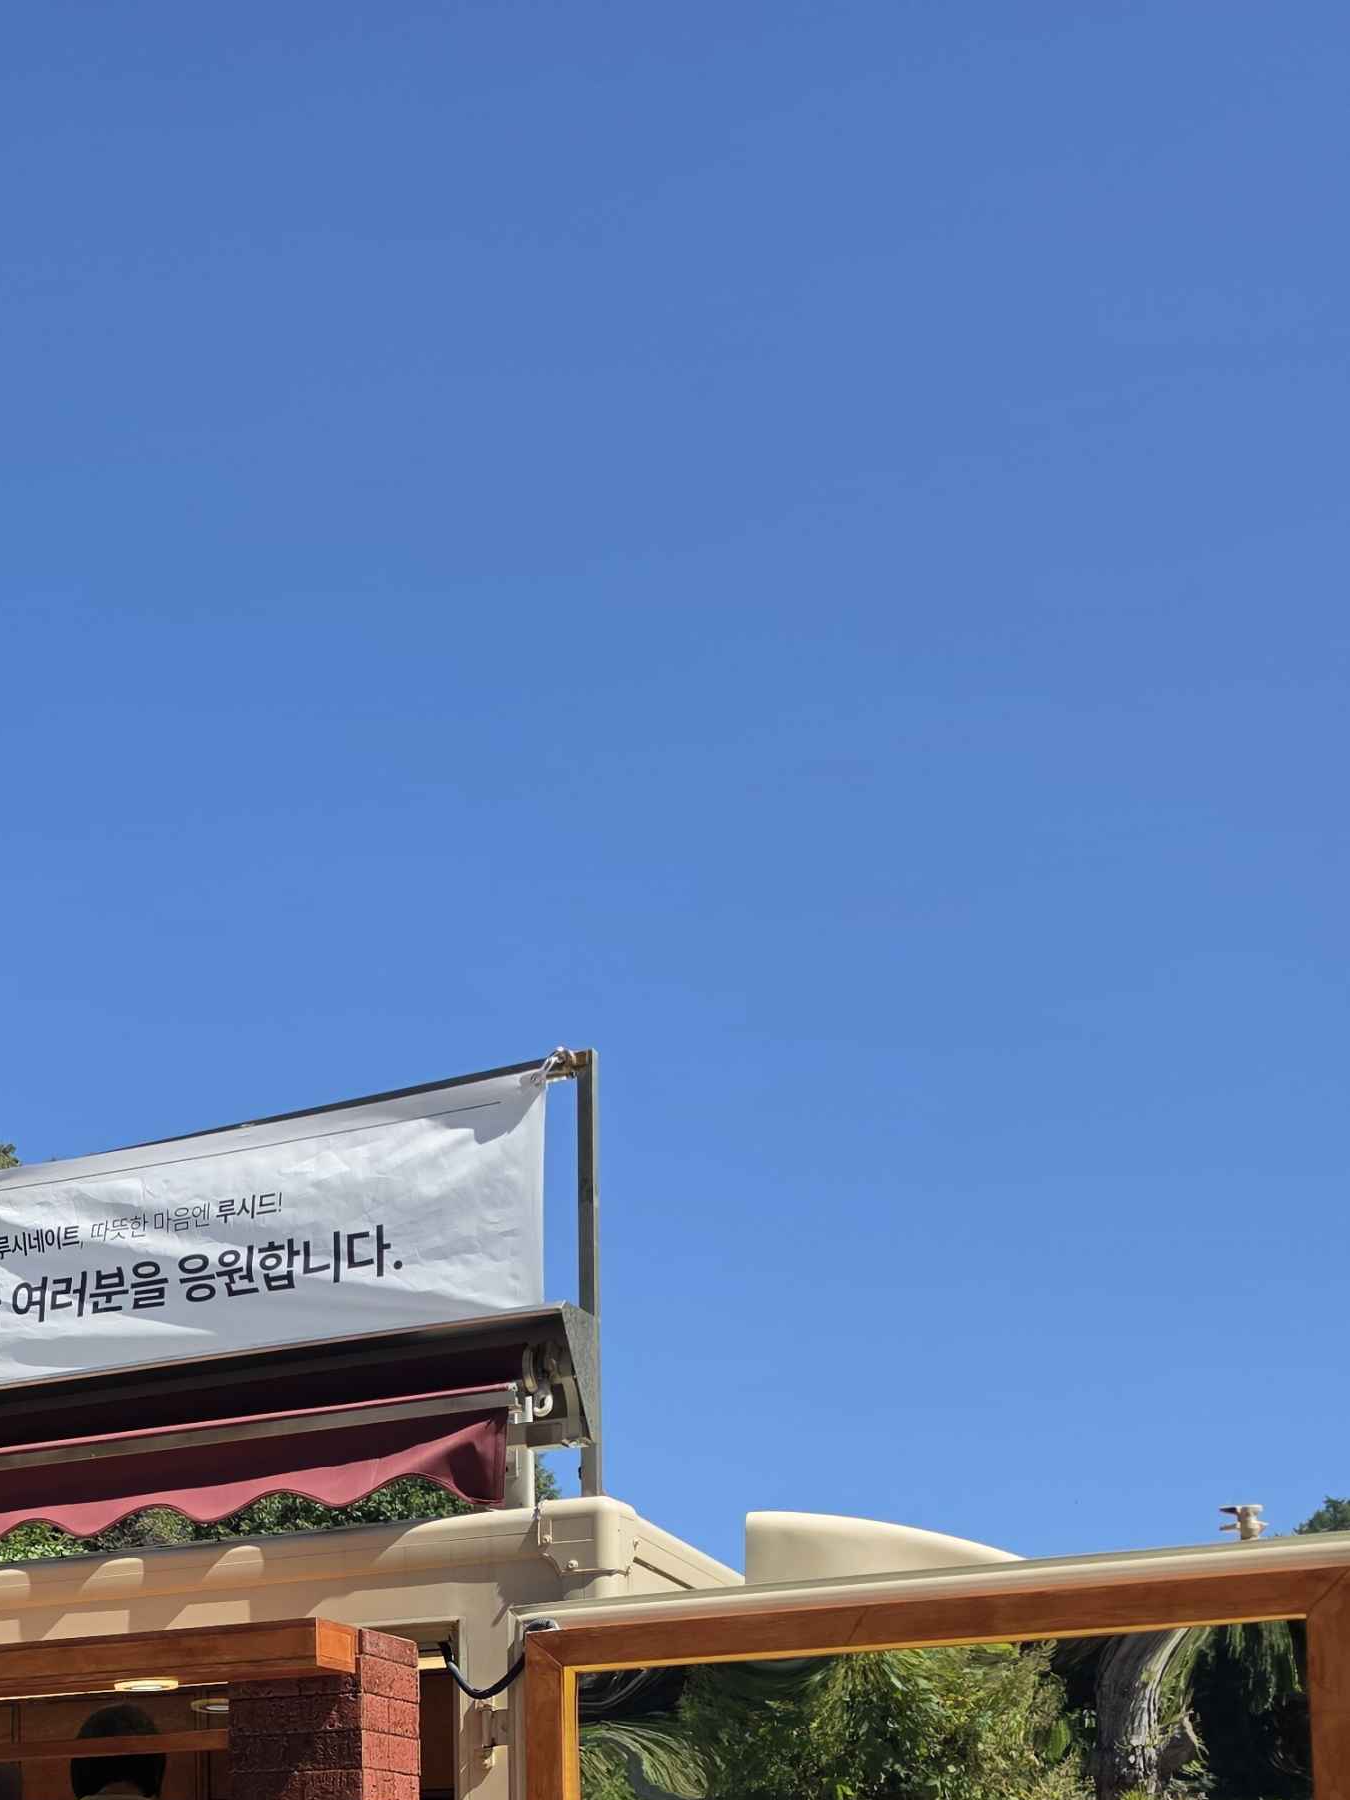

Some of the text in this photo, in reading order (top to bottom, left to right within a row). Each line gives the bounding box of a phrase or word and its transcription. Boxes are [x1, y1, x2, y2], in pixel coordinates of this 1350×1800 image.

[90, 1211, 149, 1242] 따뜻한
[153, 1203, 211, 1234] 마음엔
[215, 1190, 284, 1225] 루시드!
[11, 1258, 167, 1324] 여러분을
[178, 1223, 404, 1303] 응원합니다.
